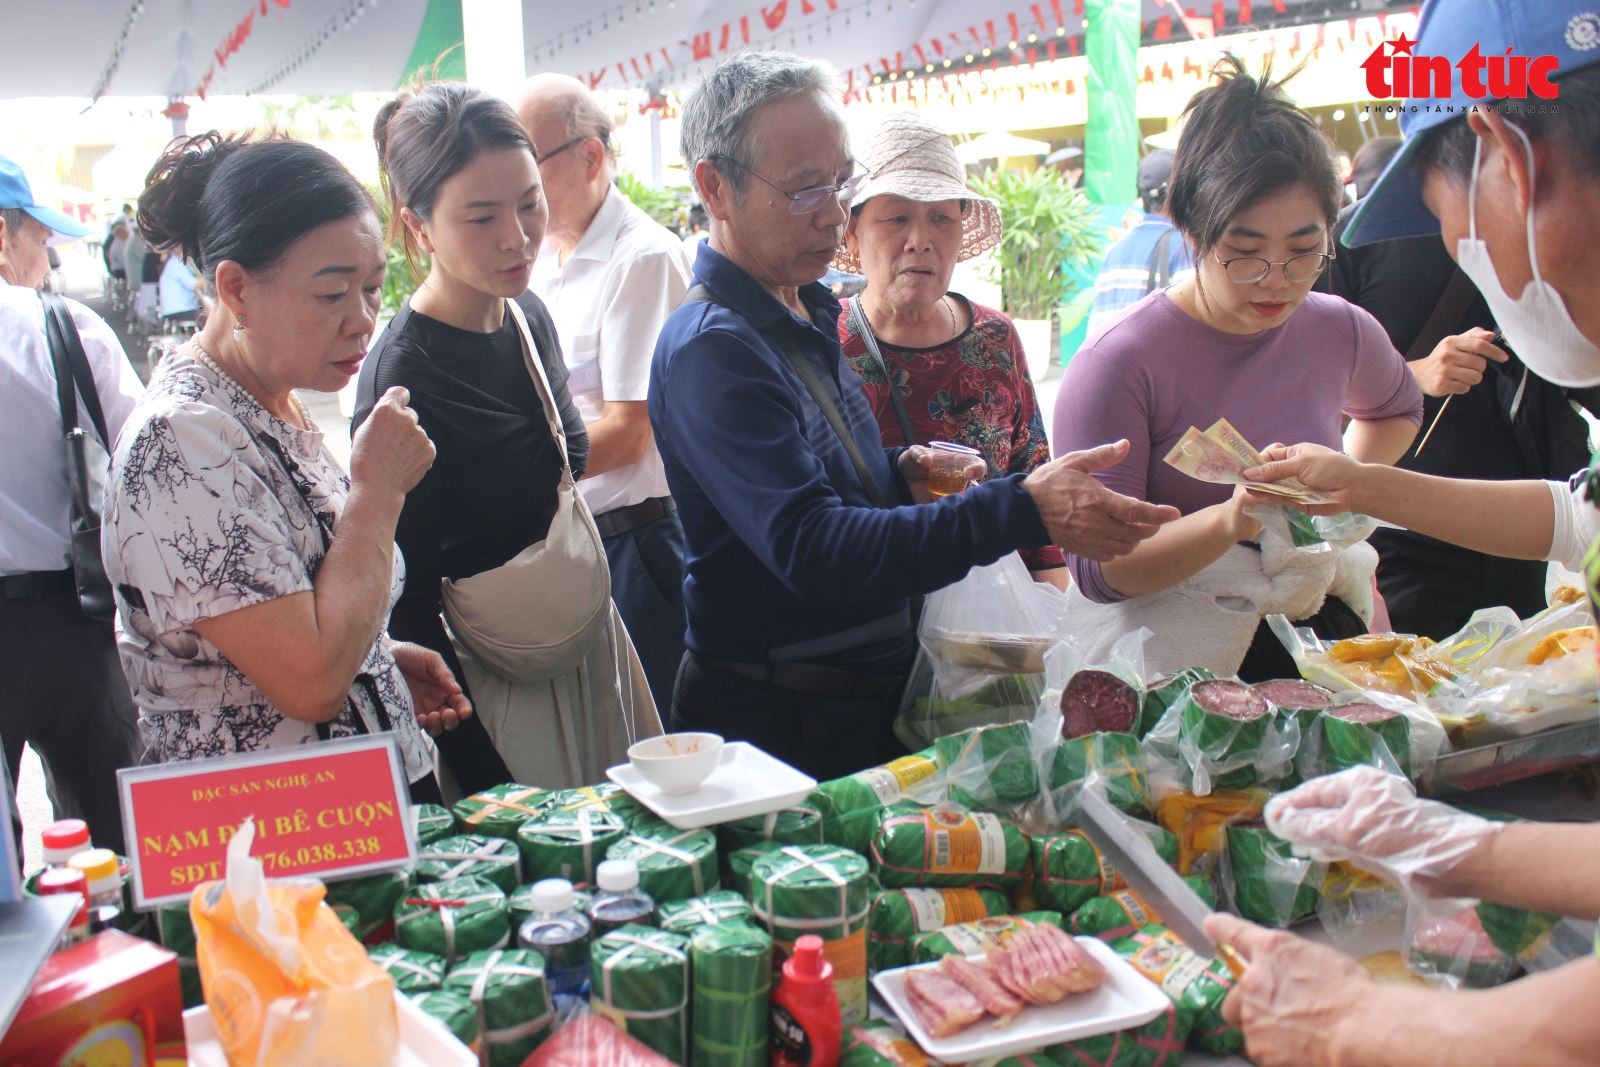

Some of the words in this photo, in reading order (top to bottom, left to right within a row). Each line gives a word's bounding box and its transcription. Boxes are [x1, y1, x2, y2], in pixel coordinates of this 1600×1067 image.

[265, 773, 310, 791] NGHỆ
[314, 769, 336, 783] AN
[144, 829, 209, 856] NẠM
[217, 819, 267, 844] ĐI
[275, 808, 310, 835] BÊ
[316, 800, 394, 827] CUỘN
[170, 861, 222, 885] SĐT
